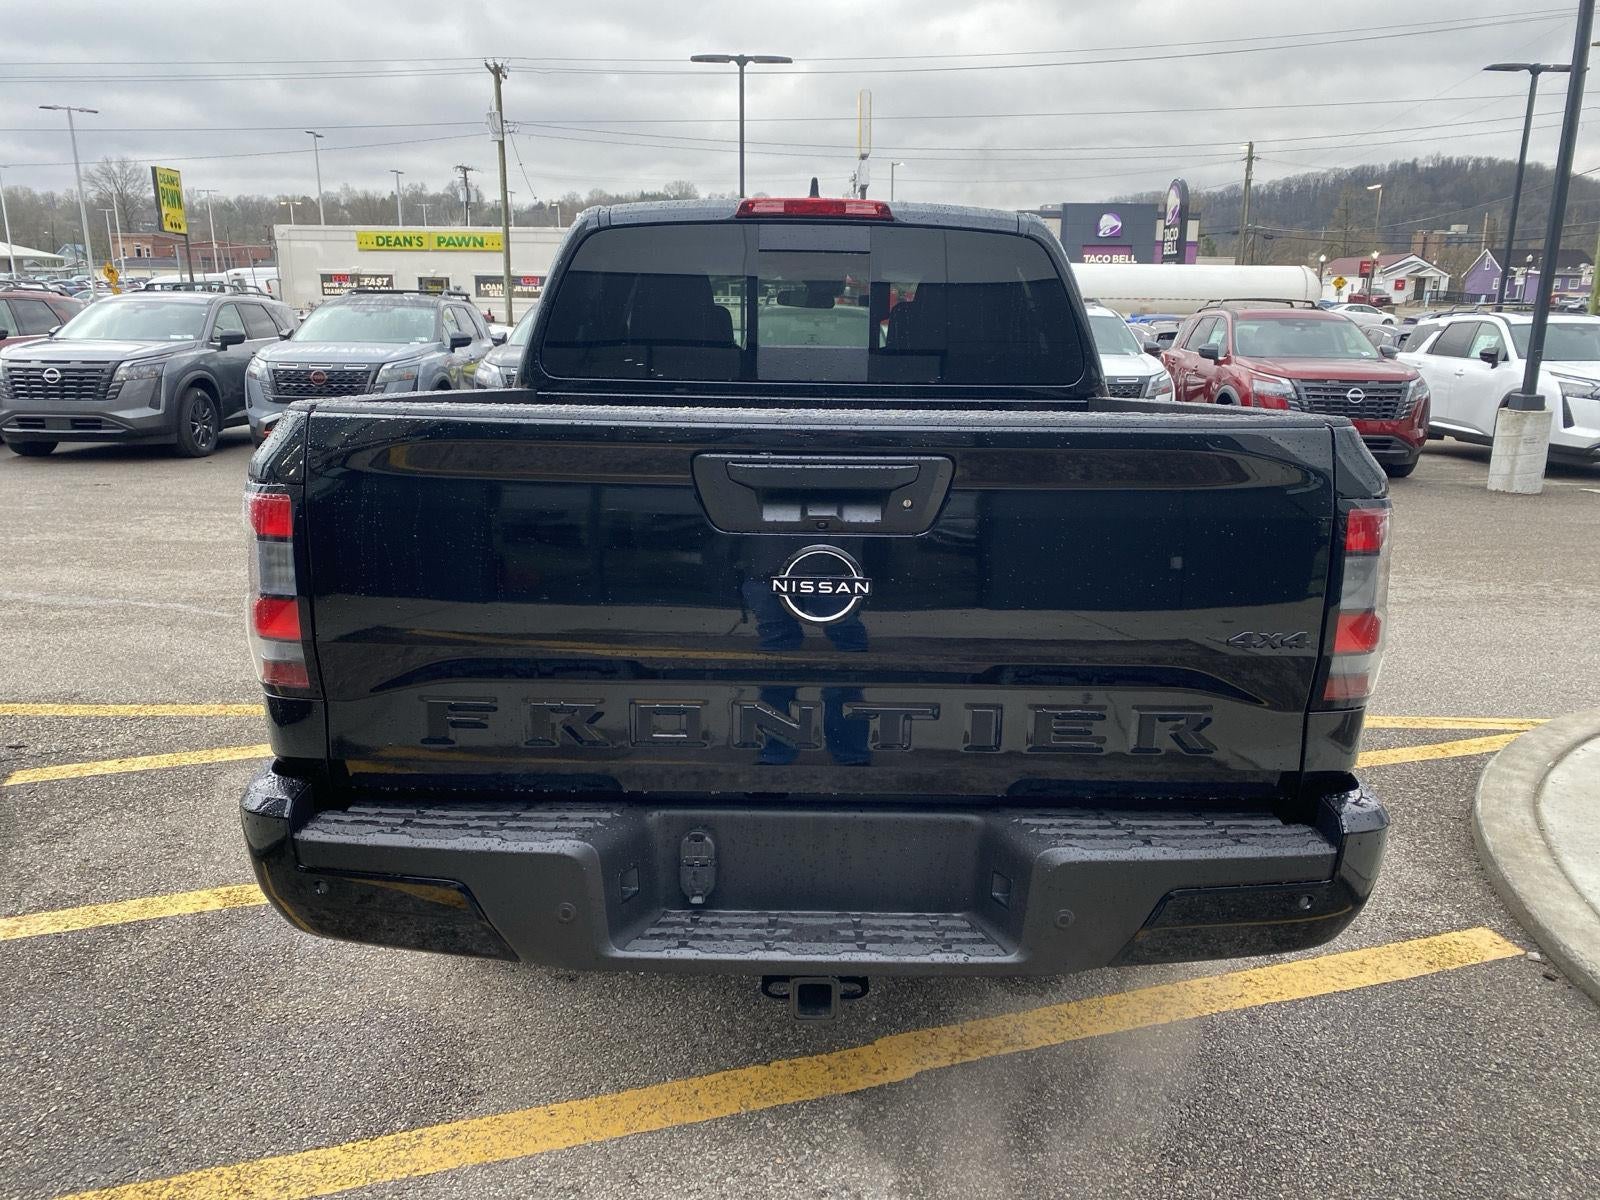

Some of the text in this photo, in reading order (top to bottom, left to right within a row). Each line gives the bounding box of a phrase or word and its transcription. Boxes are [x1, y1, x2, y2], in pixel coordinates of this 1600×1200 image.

[159, 173, 179, 187] DEAN'S
[160, 186, 182, 210] PAWN
[375, 235, 485, 247] DEAN'S PAWN
[1163, 227, 1179, 241] TACO
[1163, 241, 1177, 255] BELL
[1083, 254, 1137, 264] TACO BELL
[364, 278, 389, 286] FAST
[772, 579, 870, 594] NISSAN
[417, 694, 1219, 755] FRONTIER
